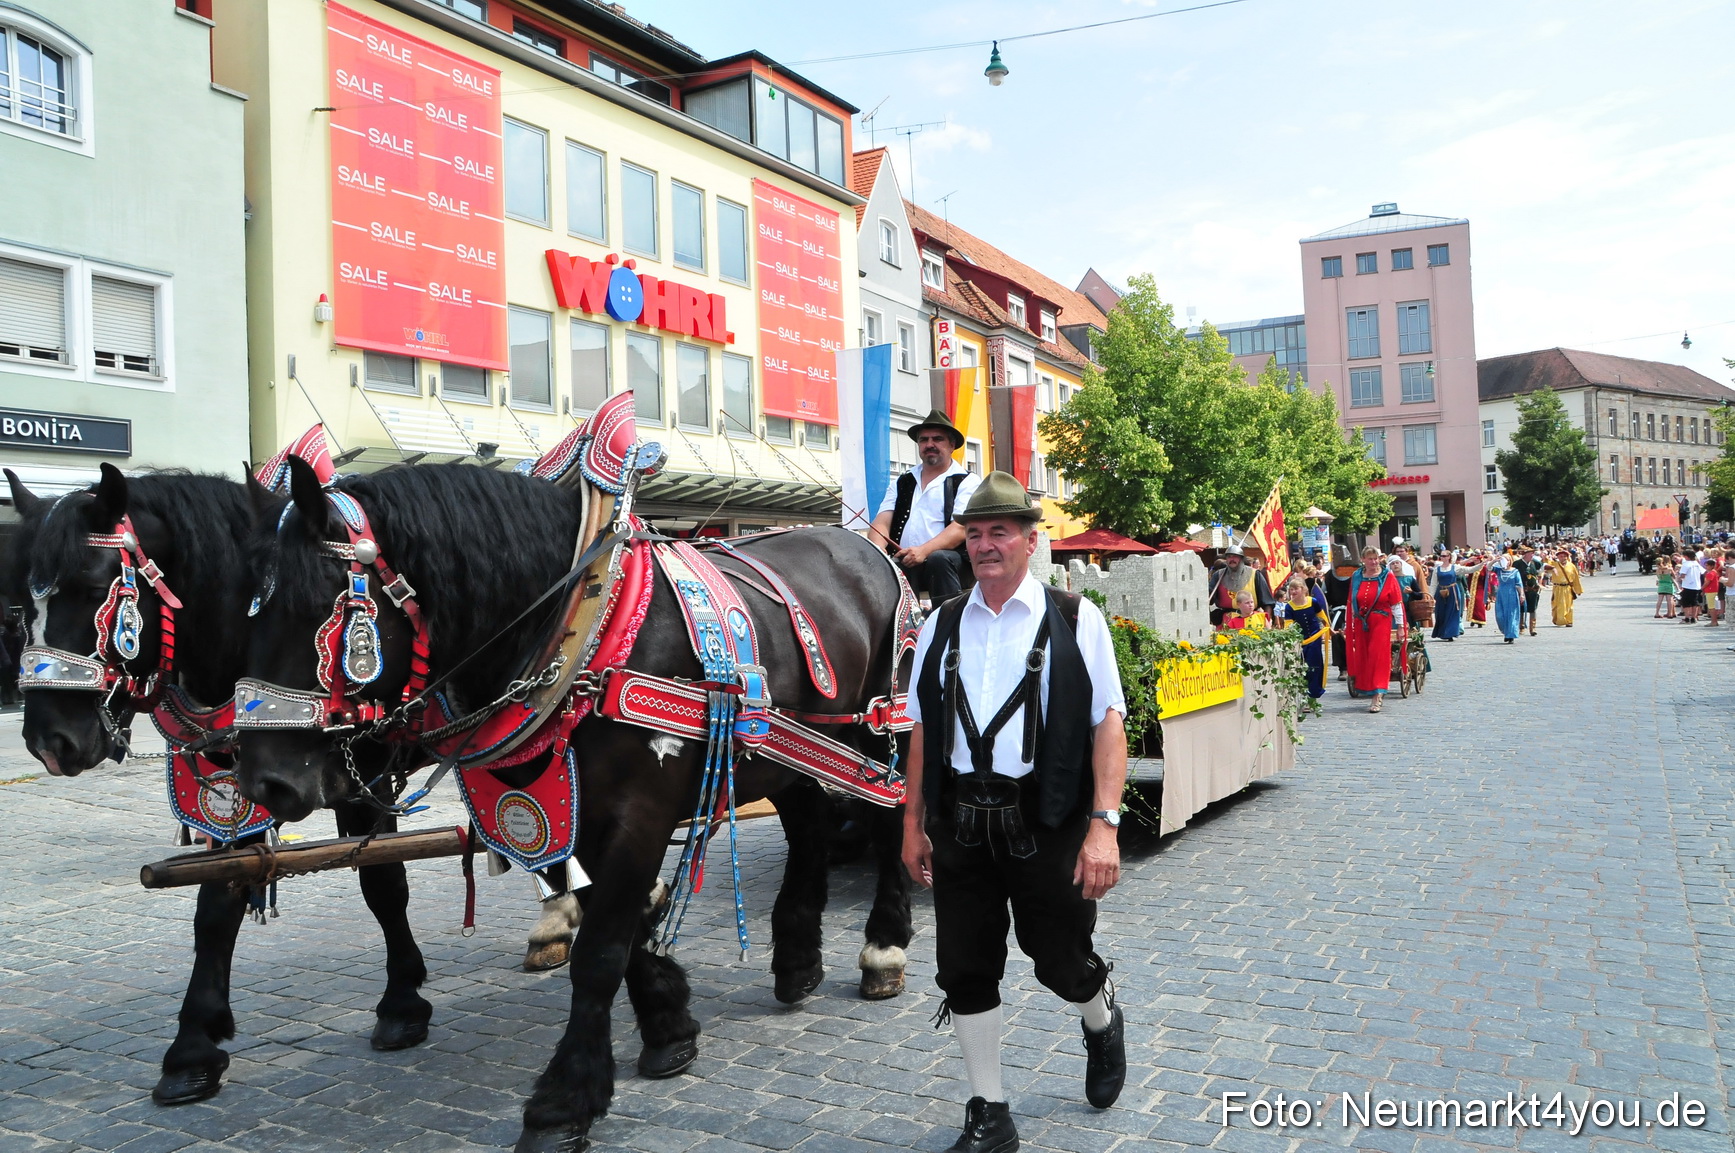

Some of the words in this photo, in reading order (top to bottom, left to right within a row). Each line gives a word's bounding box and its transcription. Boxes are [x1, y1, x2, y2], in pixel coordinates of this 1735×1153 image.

[366, 34, 413, 65] SALE
[452, 68, 493, 96] SALE
[336, 69, 384, 99] SALE
[425, 102, 468, 129] SALE
[368, 127, 414, 155] SALE
[454, 155, 495, 180] SALE
[338, 165, 386, 192] SALE
[428, 191, 470, 216] SALE
[772, 197, 796, 215] SALE
[814, 214, 836, 231] SALE
[370, 221, 416, 246] SALE
[456, 243, 497, 266] SALE
[759, 223, 783, 241] SALE
[803, 240, 824, 256] SALE
[340, 262, 388, 286] SALE
[429, 282, 472, 304] SALE
[545, 248, 735, 345] WÖHRL
[775, 261, 798, 278] SALE
[817, 275, 839, 291] SALE
[762, 289, 786, 306] SALE
[804, 303, 827, 318] SALE
[778, 326, 801, 342] SALE
[820, 338, 841, 351] SALE
[764, 356, 788, 371] SALE
[807, 366, 830, 380] SALE
